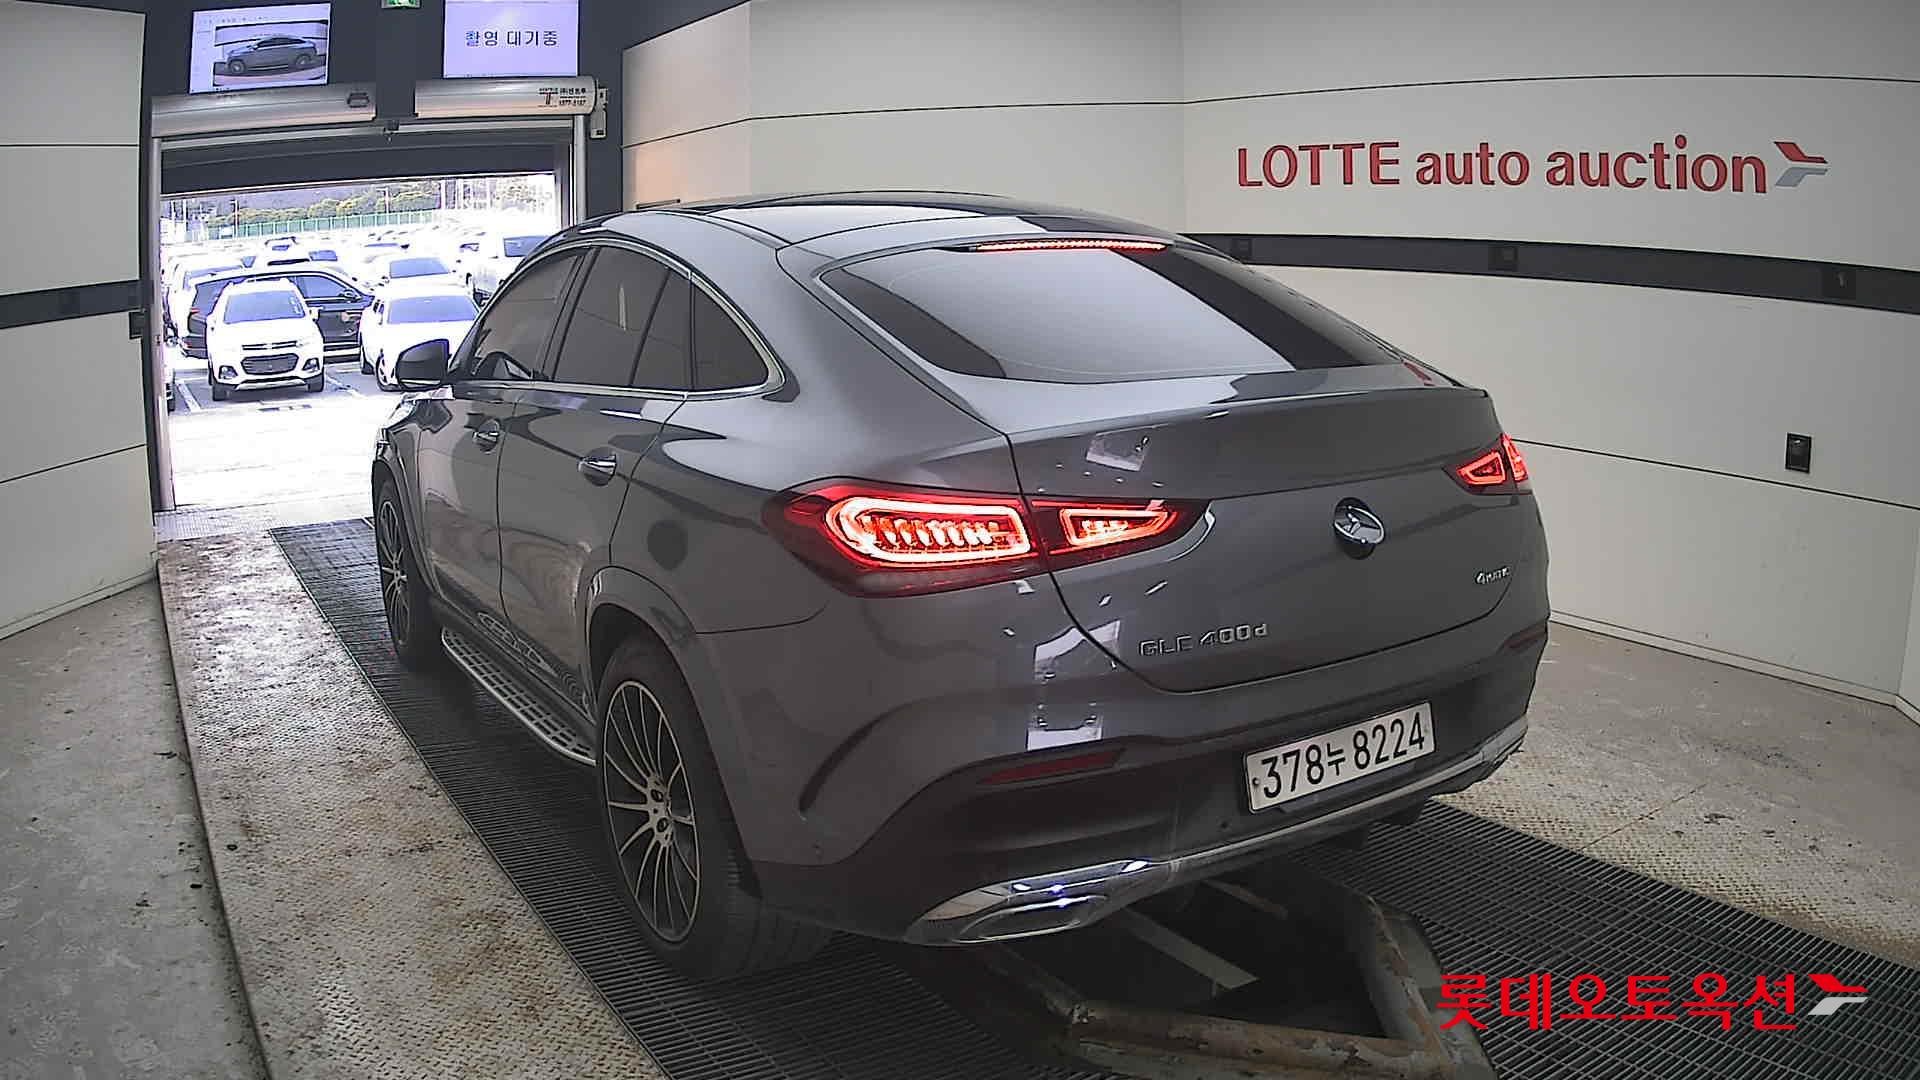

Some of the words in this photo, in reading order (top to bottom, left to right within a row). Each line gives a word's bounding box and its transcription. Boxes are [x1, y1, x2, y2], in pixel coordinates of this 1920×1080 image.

[465, 30, 498, 47] 촬영
[506, 30, 558, 47] 대기중
[1238, 142, 1399, 188] LOTTE
[1416, 143, 1530, 186] auto
[1546, 135, 1767, 194] auction
[1199, 623, 1267, 646] 400d
[1261, 743, 1346, 798] 378누
[1352, 712, 1425, 770] 8224
